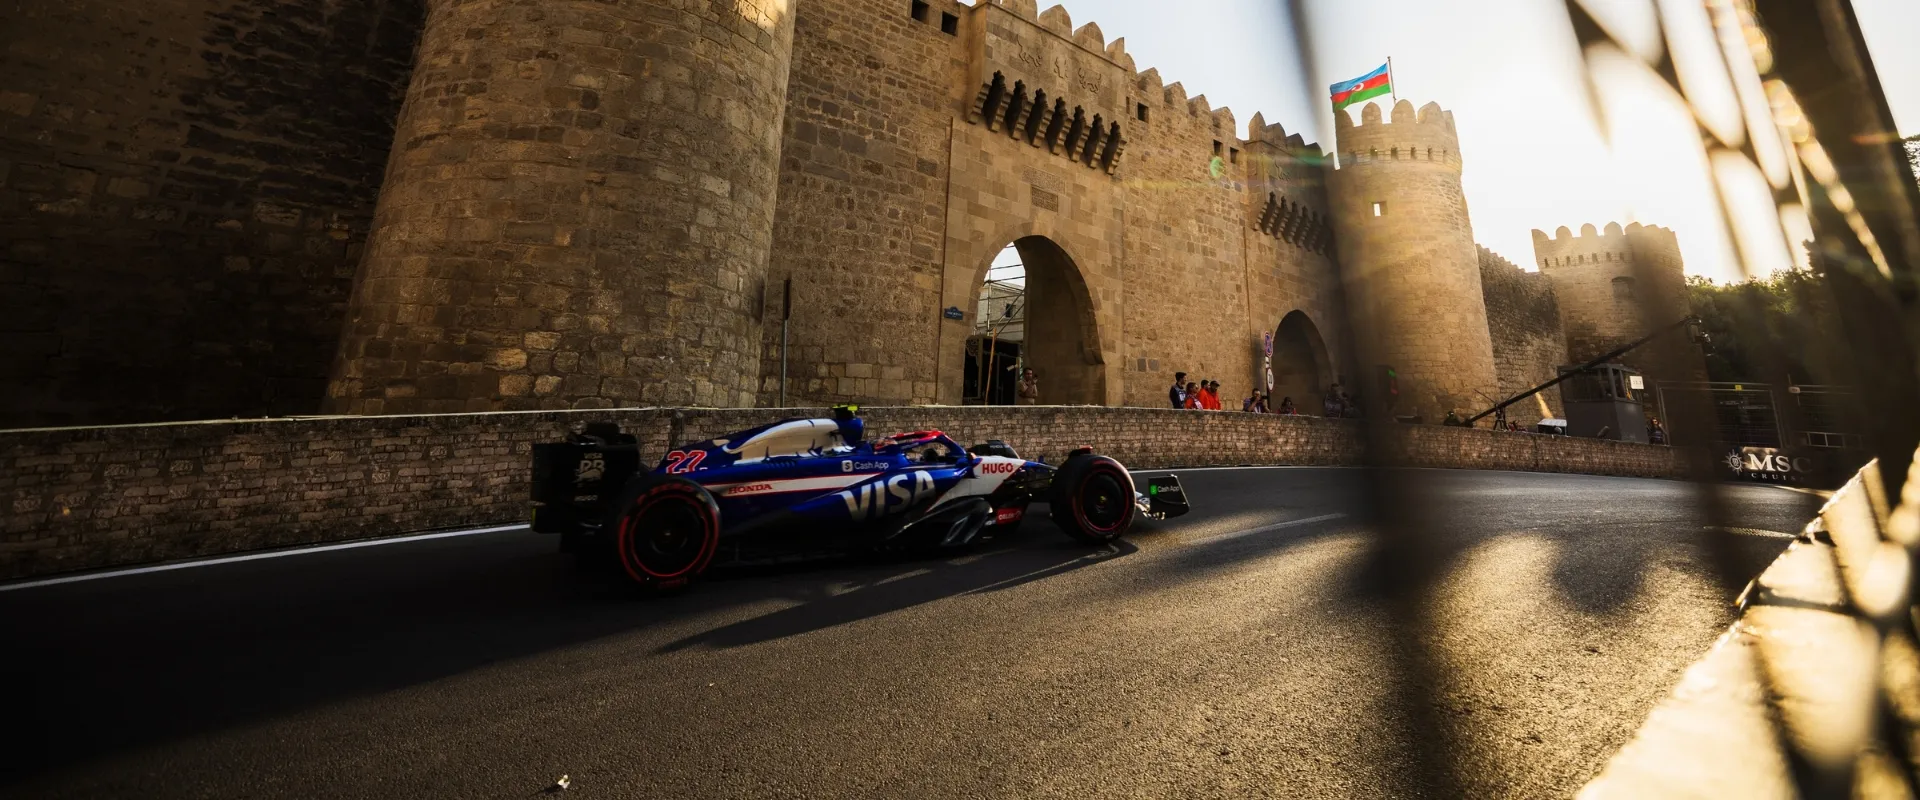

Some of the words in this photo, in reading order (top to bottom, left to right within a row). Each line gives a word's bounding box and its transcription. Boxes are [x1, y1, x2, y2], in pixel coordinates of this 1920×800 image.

[665, 449, 708, 474] 27
[854, 461, 873, 470] Cash
[874, 461, 890, 470] App
[1747, 453, 1813, 473] MSC
[982, 463, 1014, 475] HUGO
[727, 483, 773, 495] HONDA
[1157, 485, 1169, 493] Cash
[838, 469, 937, 522] VISA
